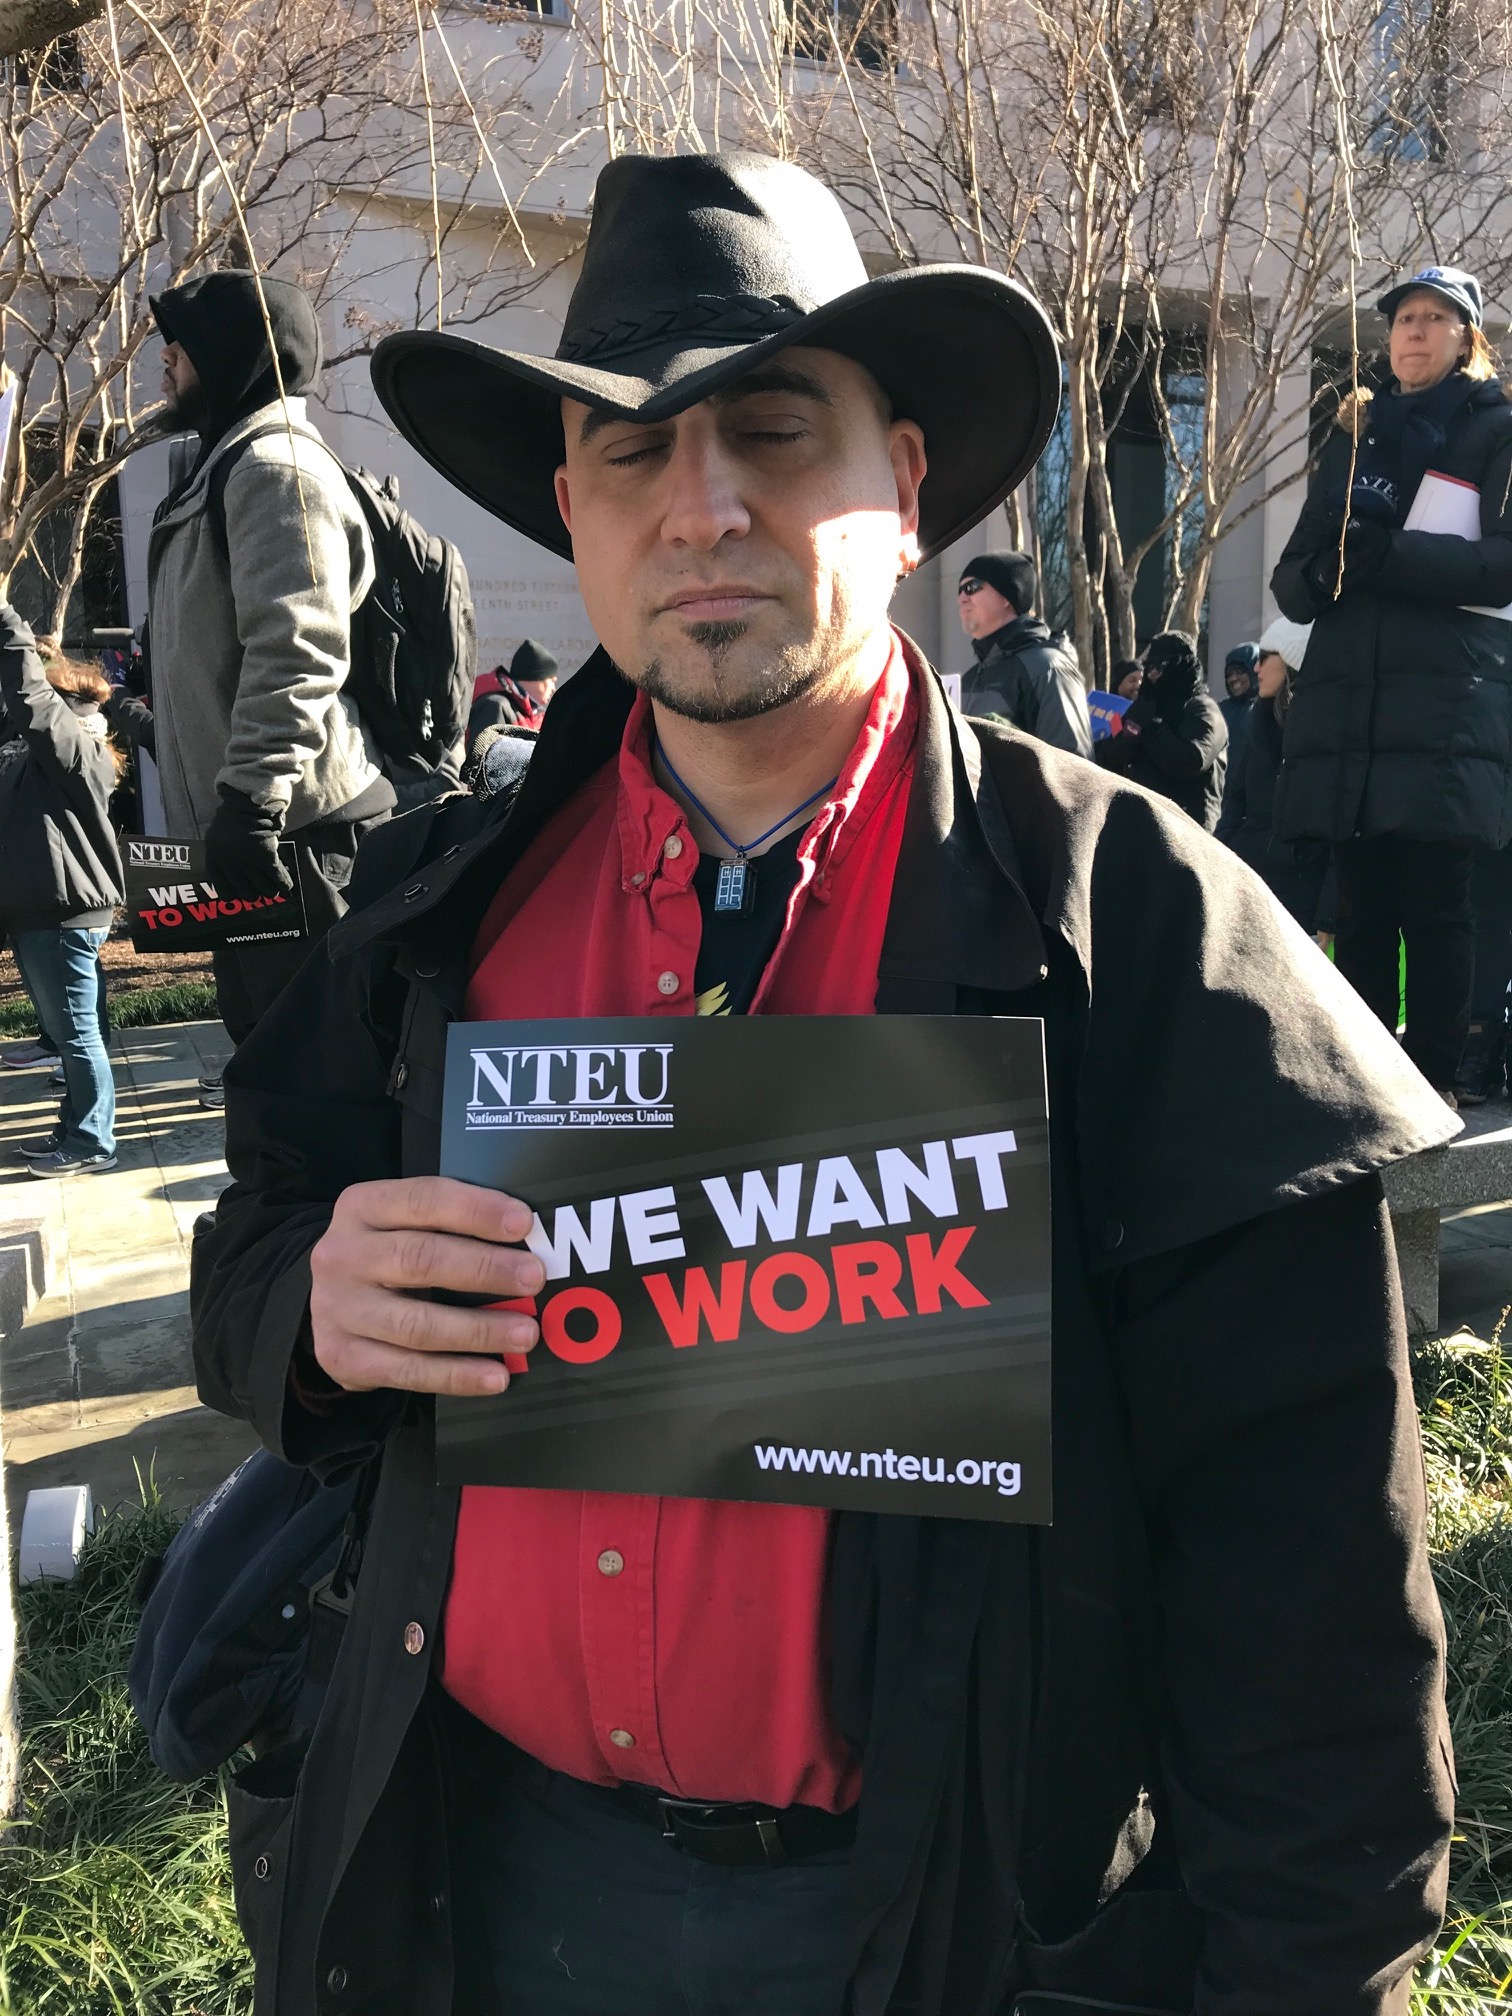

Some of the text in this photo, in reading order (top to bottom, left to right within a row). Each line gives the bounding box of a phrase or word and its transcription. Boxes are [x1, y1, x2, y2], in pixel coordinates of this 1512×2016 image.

[129, 843, 190, 863] NTEU
[148, 884, 198, 907] WE
[138, 908, 183, 930] TO
[226, 929, 300, 943] www.nteu.org
[466, 1048, 674, 1106] NTEU
[466, 1110, 674, 1126] National Treasury Employees Union
[524, 1130, 1018, 1281] WE WANT
[642, 1225, 992, 1349] WORK
[754, 1445, 1022, 1496] www.nteu.org
